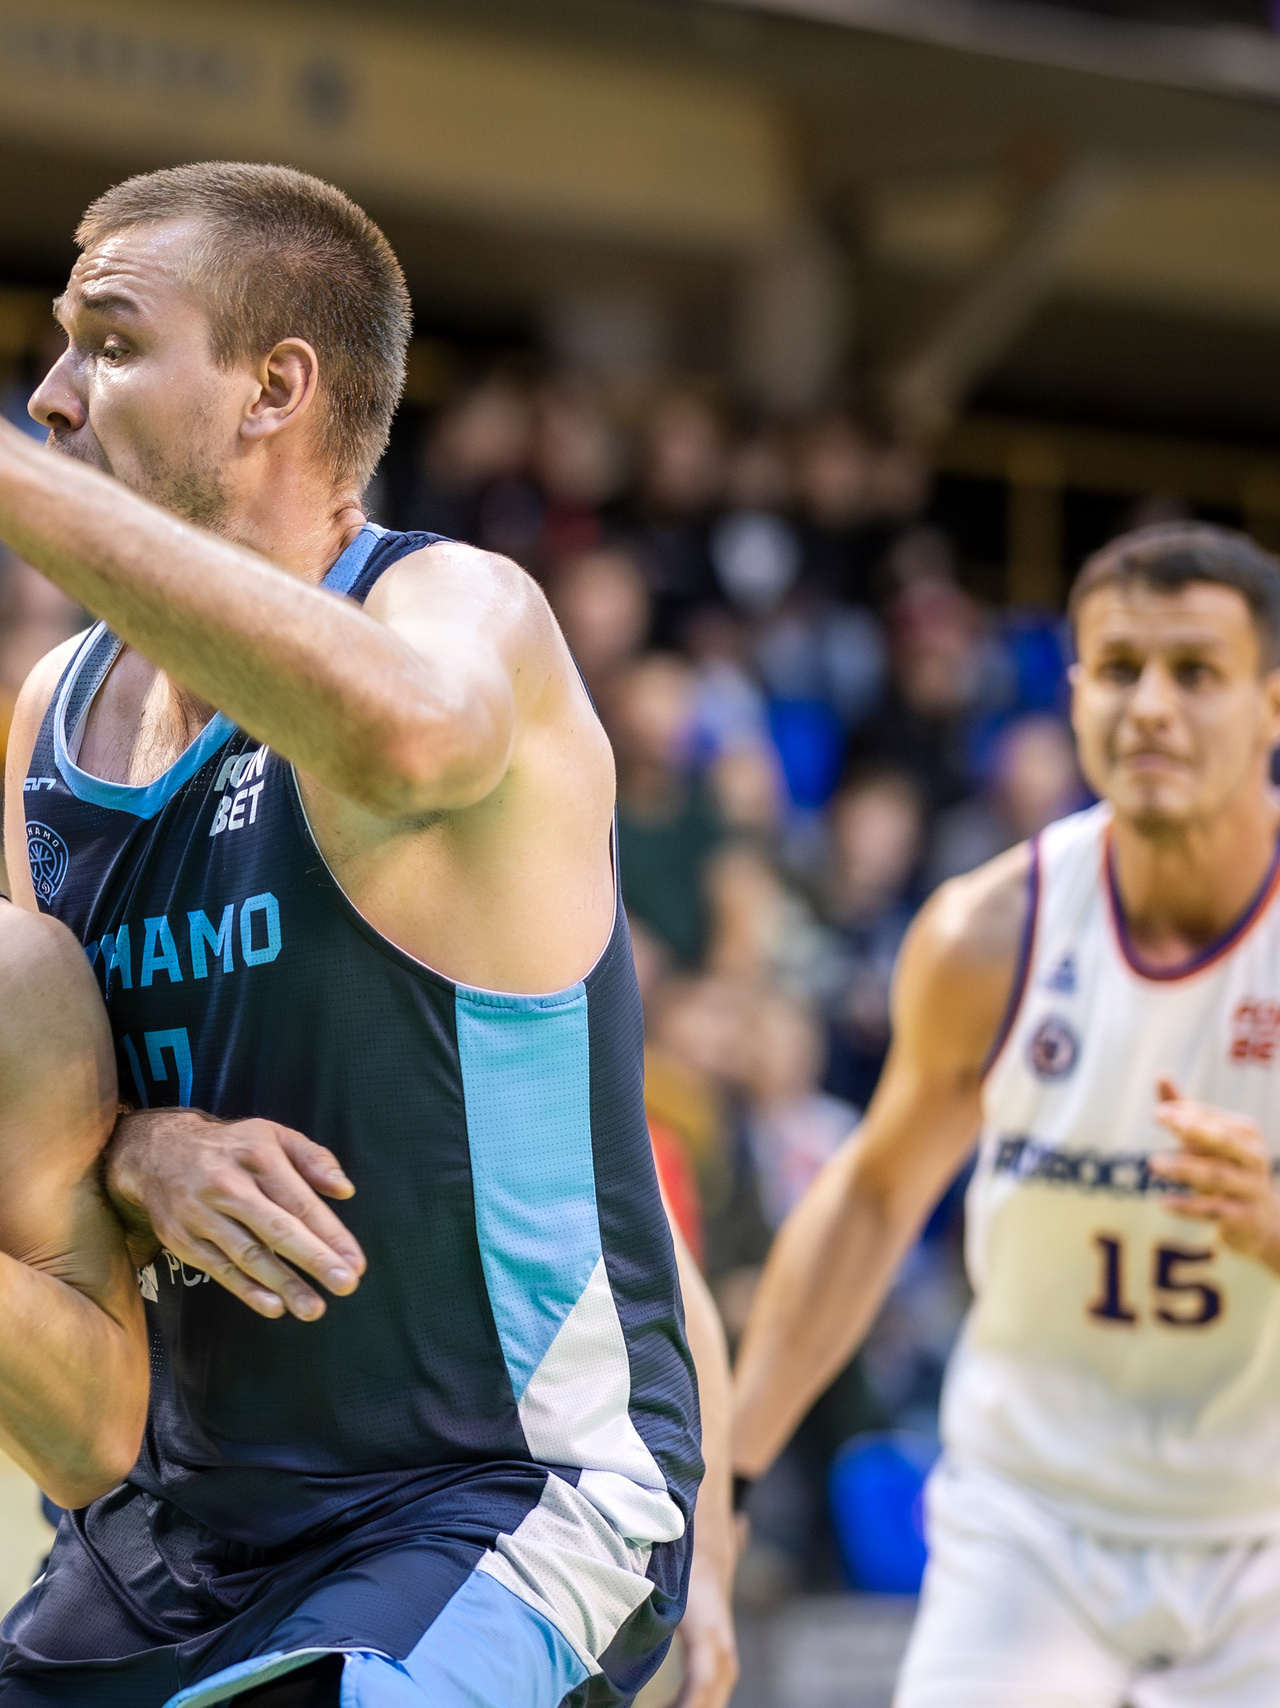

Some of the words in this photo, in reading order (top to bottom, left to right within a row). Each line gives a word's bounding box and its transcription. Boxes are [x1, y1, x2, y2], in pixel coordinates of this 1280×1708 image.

[213, 743, 270, 792] FON
[208, 779, 265, 837] BET
[1083, 1228, 1227, 1334] 15
